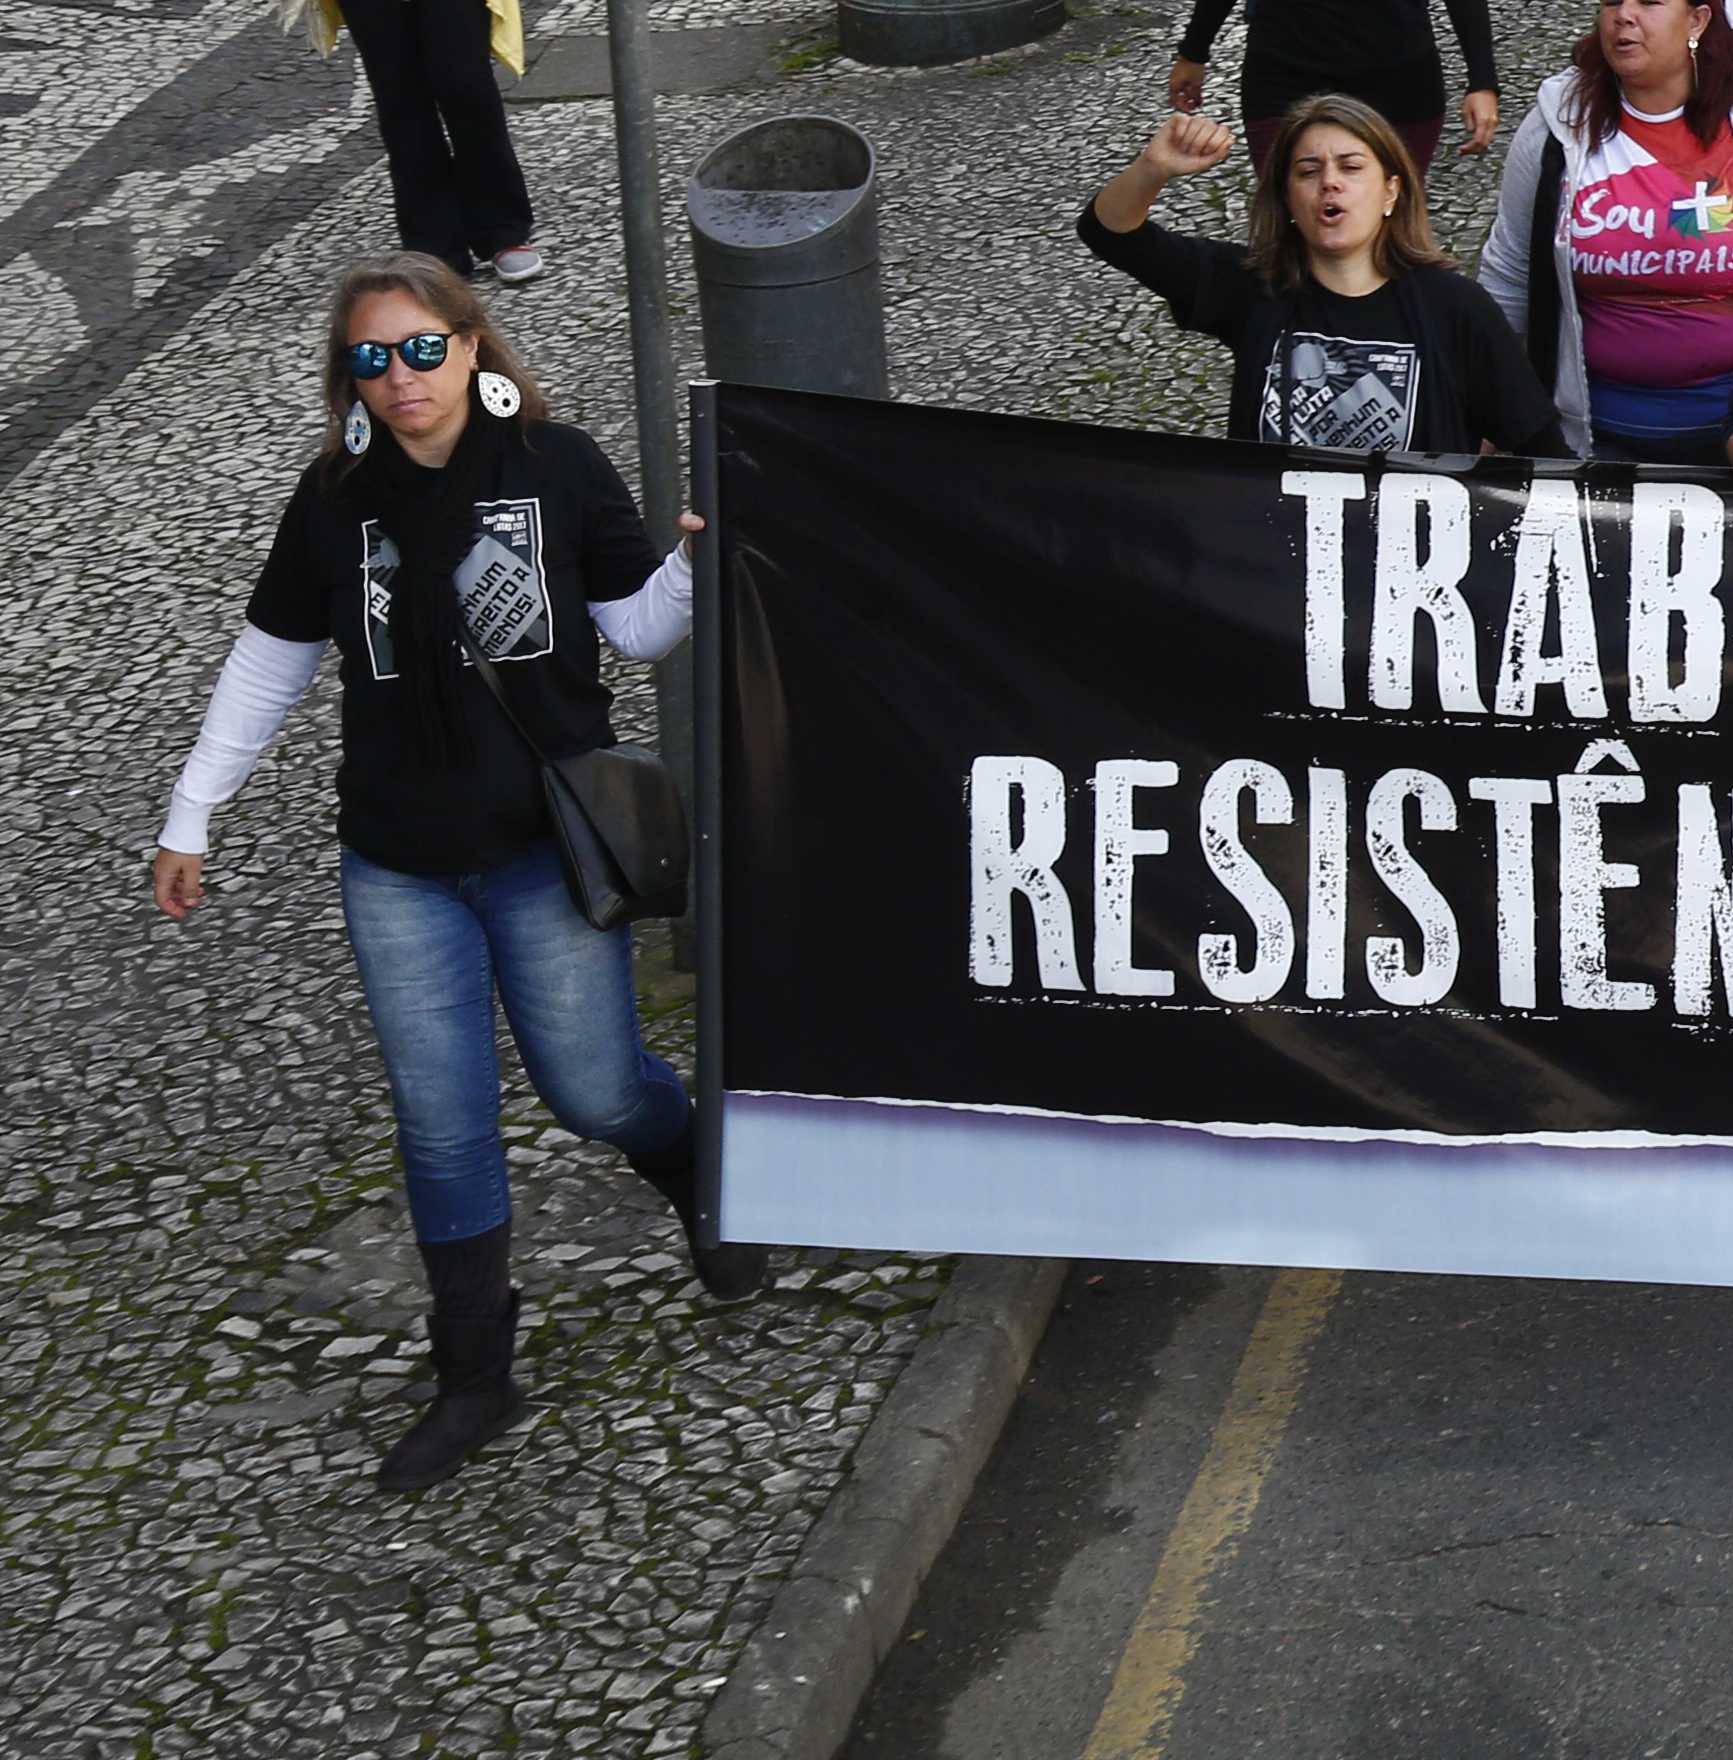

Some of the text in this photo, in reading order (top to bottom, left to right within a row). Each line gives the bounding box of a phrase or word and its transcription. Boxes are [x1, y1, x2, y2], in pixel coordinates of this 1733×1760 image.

[1293, 385, 1335, 424] LUTA
[1308, 408, 1340, 442] POR
[512, 566, 531, 583] A
